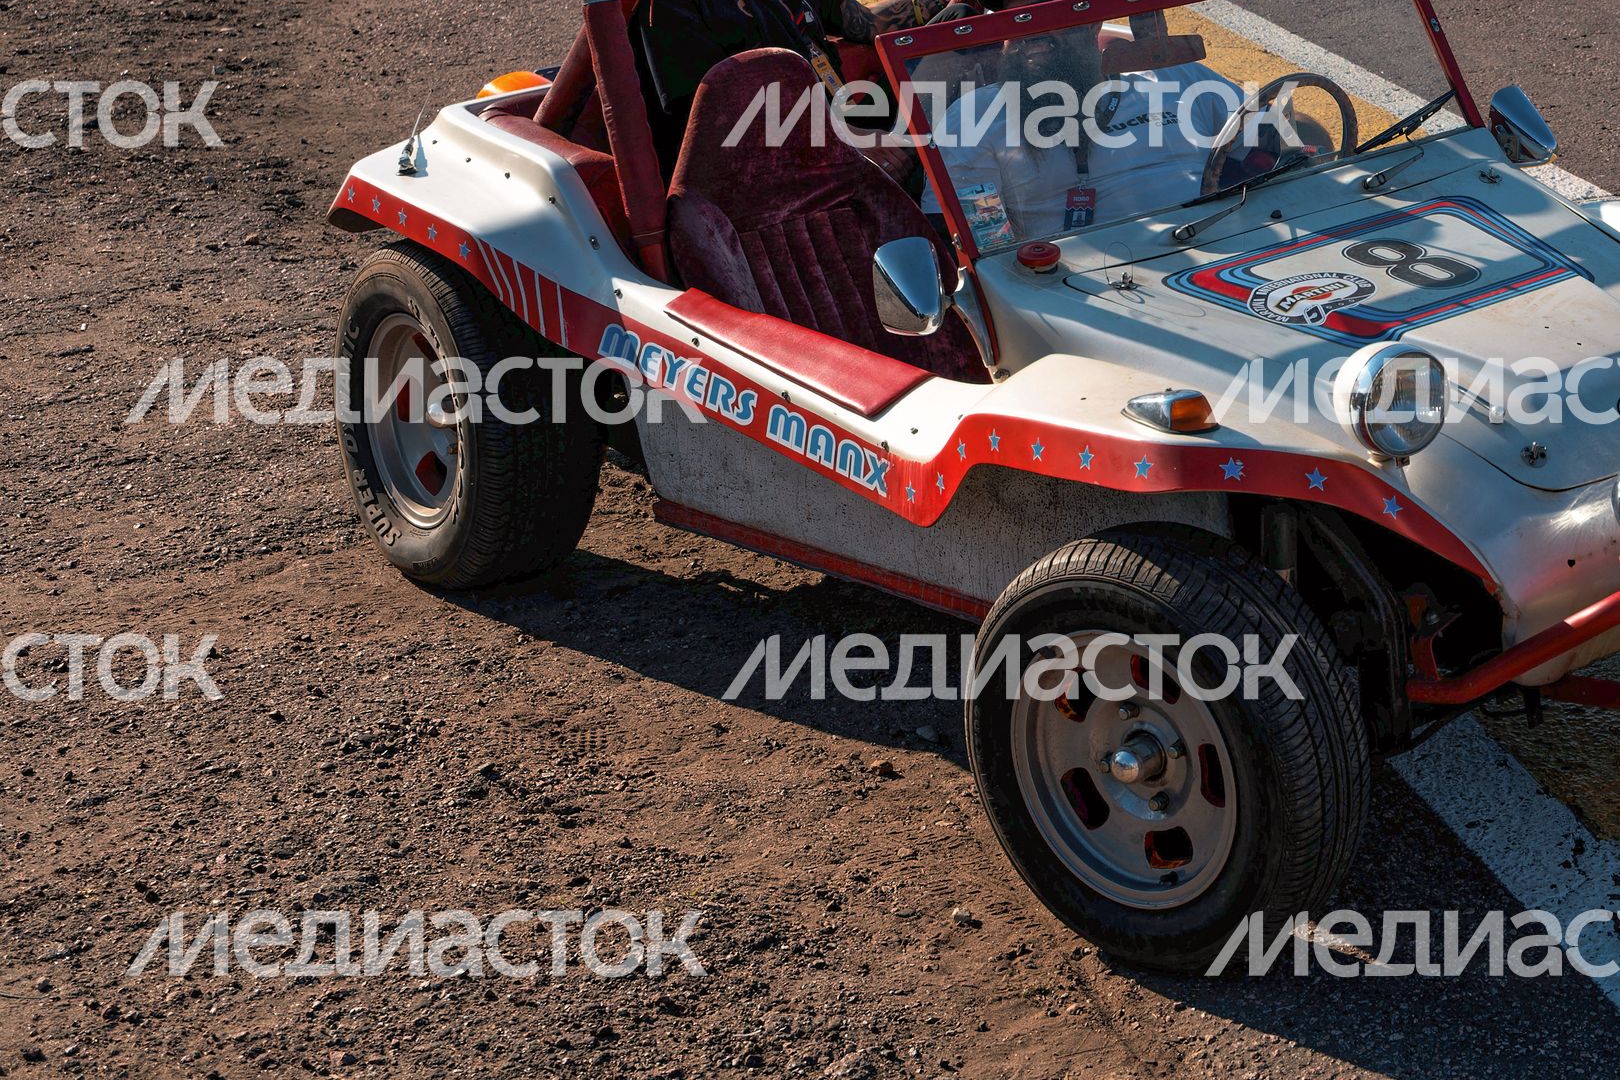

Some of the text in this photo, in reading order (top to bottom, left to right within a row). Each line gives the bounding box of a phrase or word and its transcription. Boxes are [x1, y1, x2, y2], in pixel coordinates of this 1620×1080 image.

[1255, 272, 1341, 296] INTERNATIONAL
[1343, 274, 1372, 289] CLUB
[1341, 237, 1482, 290] 8
[1279, 282, 1346, 310] MARTINI
[597, 322, 892, 497] MEYERS MANX
[357, 468, 403, 547] SUPER
